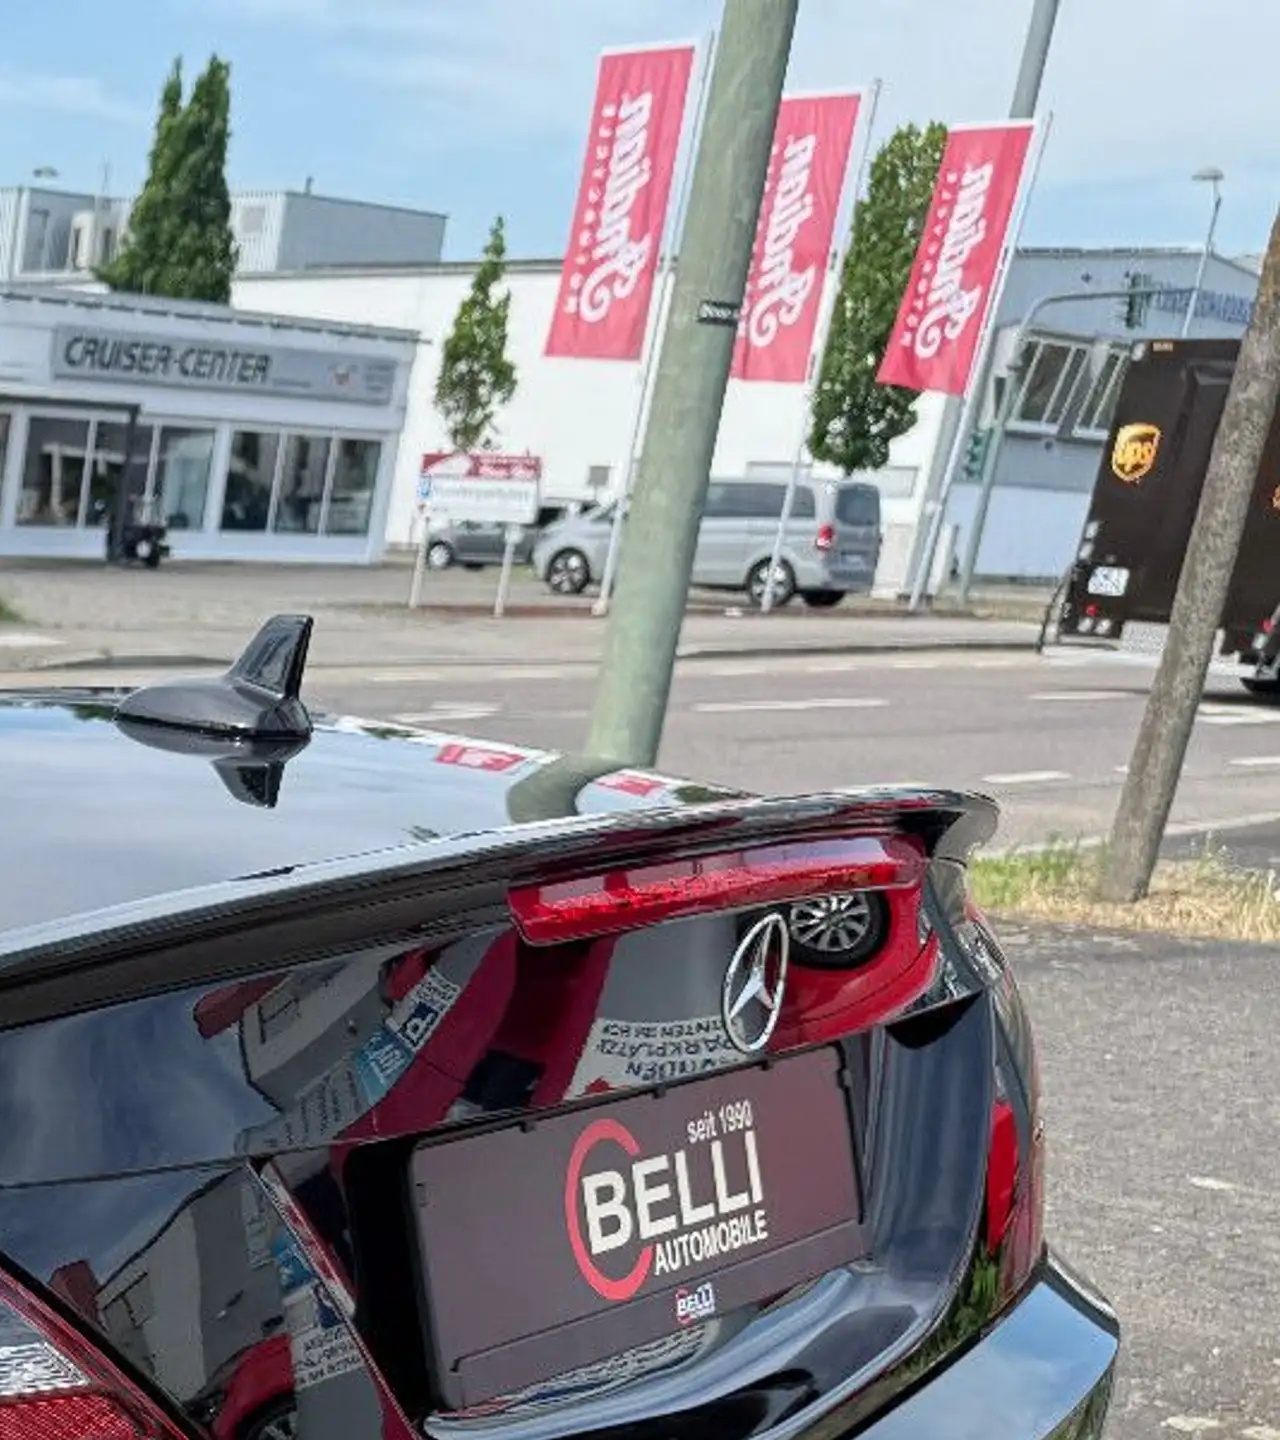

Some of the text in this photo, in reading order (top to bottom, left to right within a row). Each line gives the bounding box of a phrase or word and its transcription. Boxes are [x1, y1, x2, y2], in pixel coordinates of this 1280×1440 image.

[580, 91, 653, 323] Indian
[64, 335, 272, 386] CRUISER-CENTER
[687, 1099, 754, 1143] seit 1990
[581, 1129, 764, 1256] BELLI
[654, 1209, 769, 1276] AUTOMOBILE
